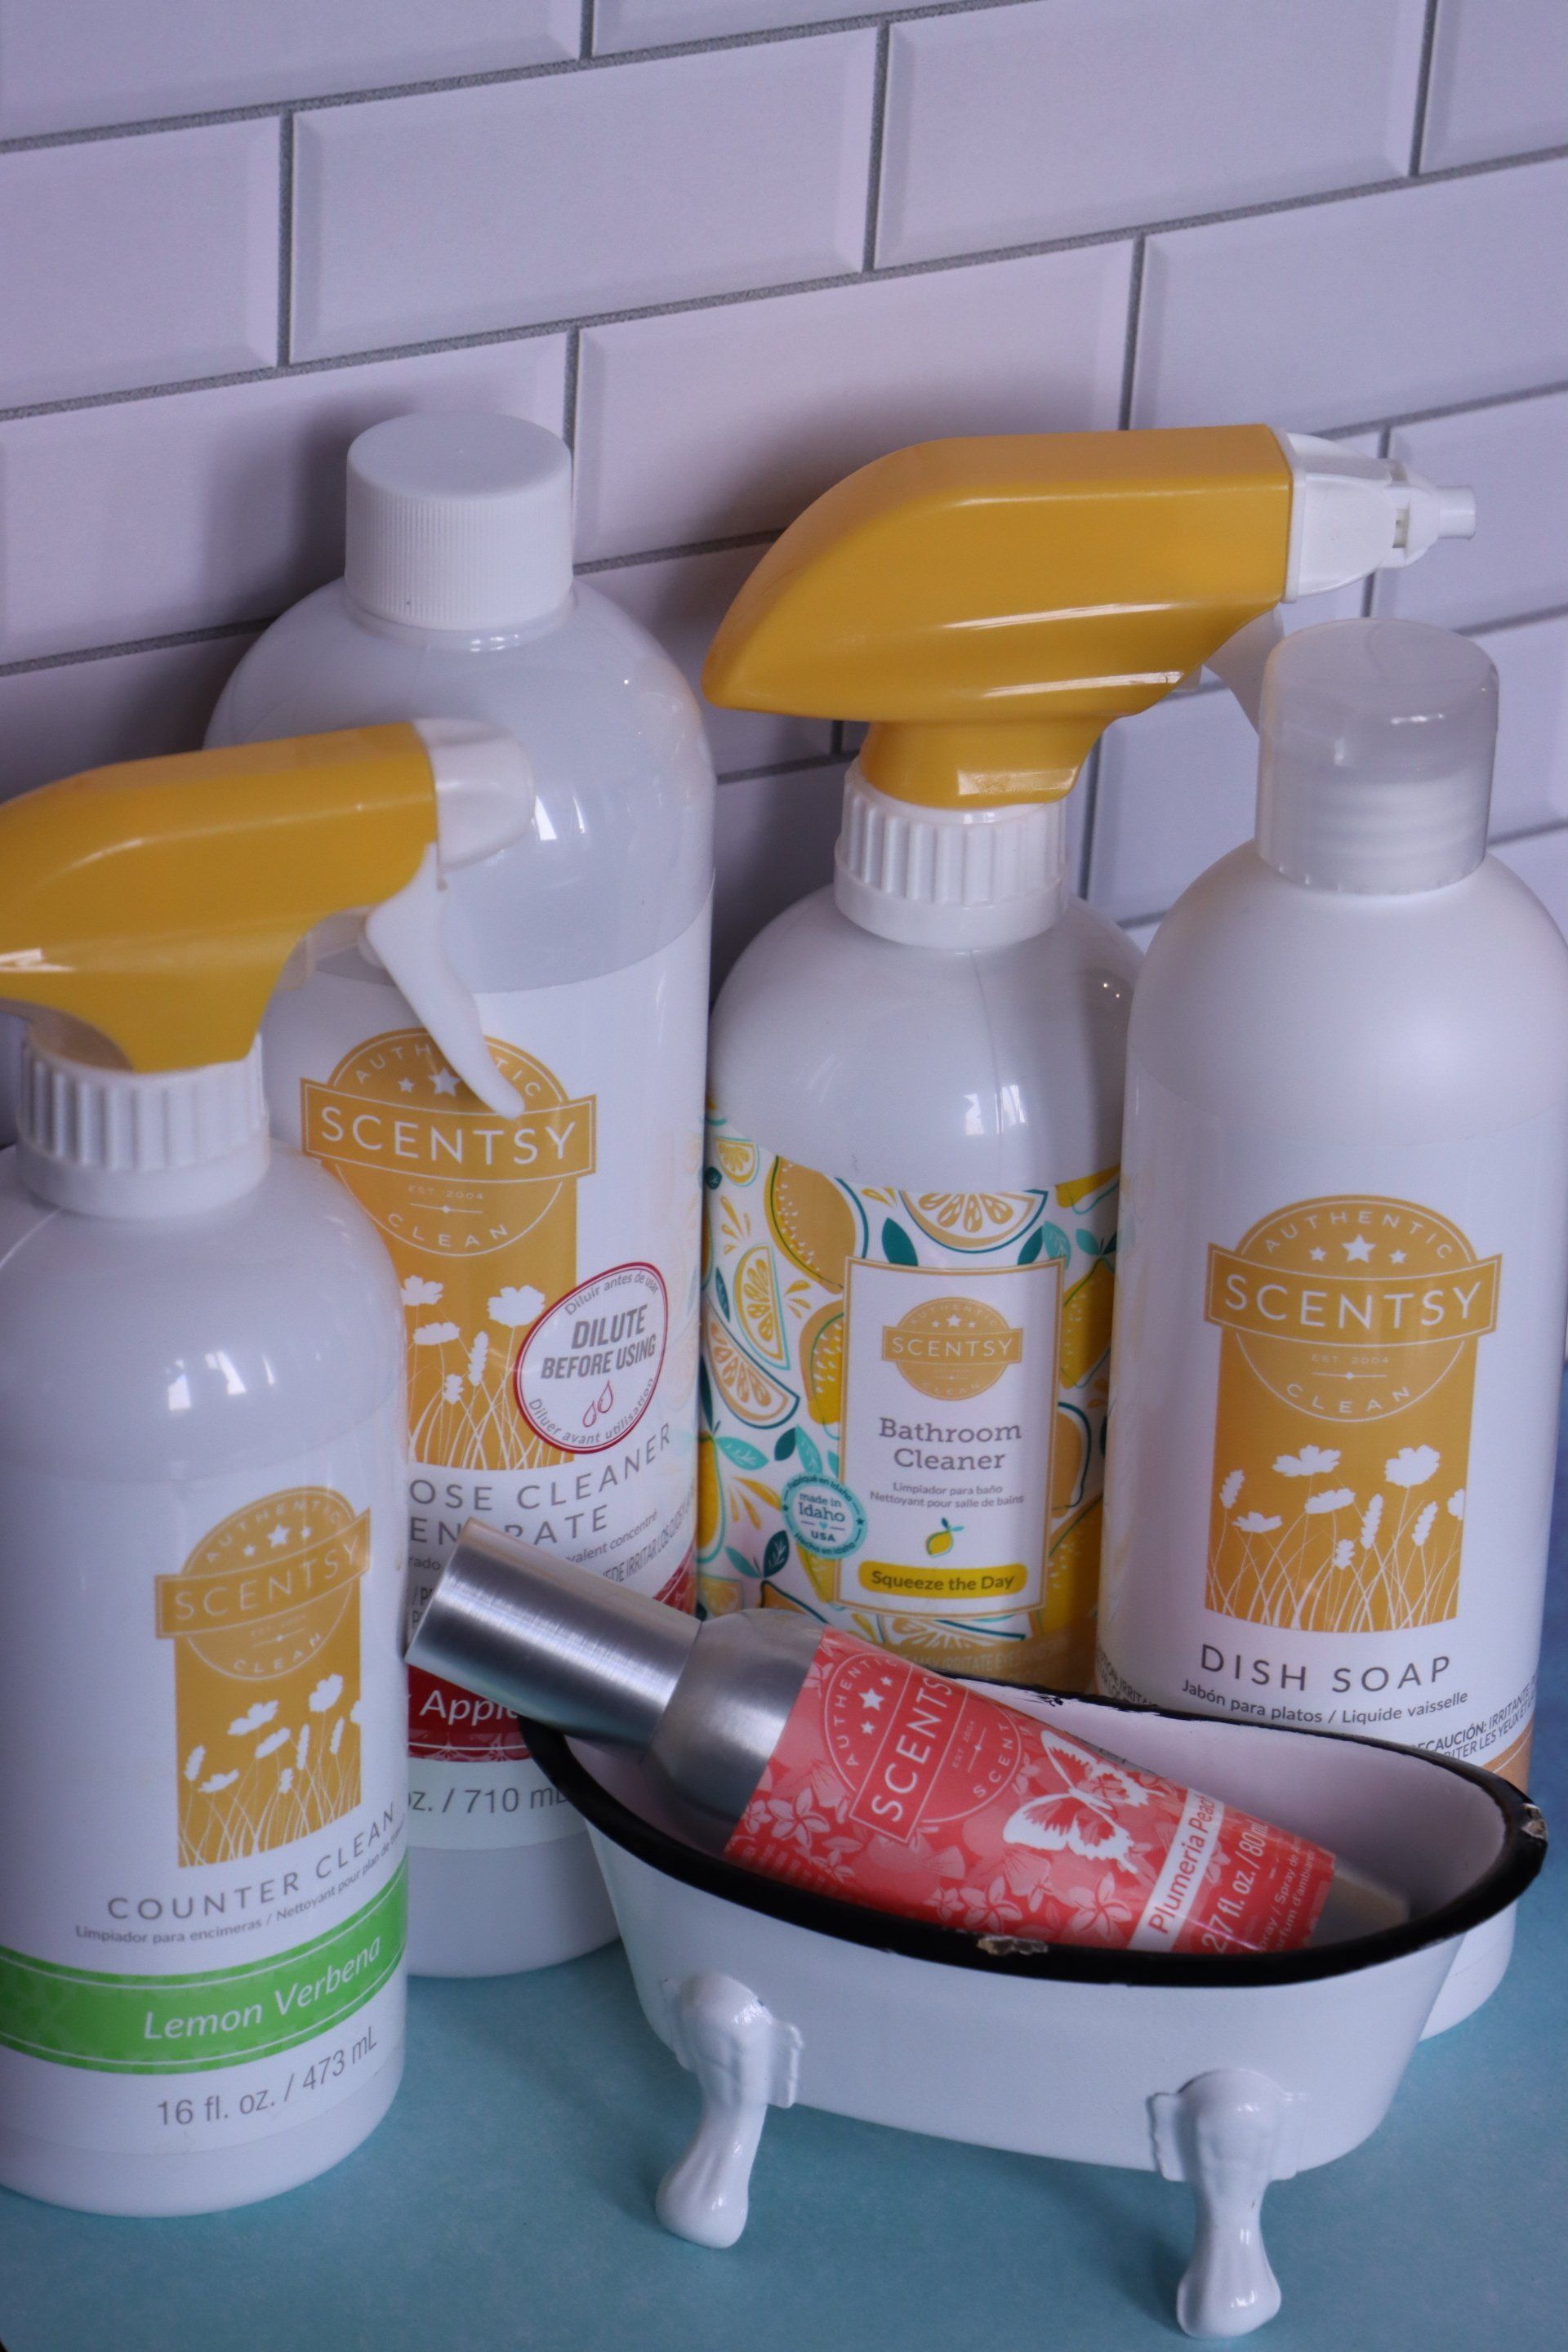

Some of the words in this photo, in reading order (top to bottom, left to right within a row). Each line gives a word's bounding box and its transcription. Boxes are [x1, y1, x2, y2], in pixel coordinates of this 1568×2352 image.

[356, 1044, 541, 1097] AUTHTIC
[321, 1106, 576, 1165] SCENTSY
[388, 1214, 508, 1247] CLEAN
[1266, 1210, 1452, 1258] AUTHENTIC
[564, 1285, 600, 1316] Diluir
[604, 1273, 632, 1291] antes
[634, 1271, 645, 1284] de
[1225, 1273, 1481, 1330] SCENTSY
[571, 1304, 648, 1349] DILUTE
[892, 1336, 1013, 1357] SCENTSY
[541, 1351, 613, 1379] BEFORE
[616, 1334, 657, 1370] USING
[1312, 1353, 1339, 1363] EST
[1352, 1356, 1389, 1365] 2004
[528, 1397, 562, 1435] Diluer
[562, 1432, 601, 1445] avant
[605, 1378, 654, 1440] utilisation
[1287, 1383, 1410, 1414] CLEAN
[879, 1417, 1022, 1443] Bathroom
[517, 1423, 670, 1509] CLEANER
[893, 1448, 1006, 1470] Cleaner
[798, 1501, 845, 1522] Idaho
[799, 1493, 828, 1506] made
[831, 1497, 842, 1508] in
[870, 1491, 924, 1508] Nettoyant
[927, 1499, 951, 1508] pour
[955, 1496, 978, 1508] salle
[981, 1494, 994, 1507] de
[996, 1494, 1025, 1507] bains
[893, 1482, 947, 1496] Limpiador
[950, 1486, 973, 1496] para
[976, 1483, 1003, 1494] baño
[207, 1500, 341, 1563] AUTHENTIC
[811, 1530, 836, 1543] USA
[174, 1535, 360, 1620] SCENTSY
[871, 1570, 944, 1591] Squeeze
[948, 1576, 976, 1591] the
[981, 1575, 1015, 1590] Day
[234, 1633, 321, 1673] CLEAN
[1200, 1643, 1306, 1691] DISH
[1332, 1655, 1450, 1693] SOAP
[834, 1659, 898, 1767] AUTHENTIC
[1182, 1679, 1225, 1706] Jabón
[1230, 1698, 1265, 1716] para
[1271, 1705, 1322, 1723] platos
[1327, 1709, 1337, 1724] /
[1342, 1707, 1402, 1725] Liquide
[1406, 1690, 1468, 1717] vaisselle
[871, 1677, 952, 1823] SCENTS
[1479, 1729, 1496, 1750] LES
[1498, 1713, 1520, 1737] YEUX
[952, 1748, 964, 1768] EST
[973, 1723, 1013, 1798] SCENT
[408, 1790, 432, 1811] z.
[442, 1788, 455, 1813] /
[465, 1788, 519, 1814] 710
[108, 1871, 299, 1920] COUNTER
[315, 1802, 394, 1878] CLEAN
[1238, 1832, 1266, 1857] 80
[75, 1924, 148, 1943] Limpiador
[153, 1931, 185, 1944] para
[189, 1918, 261, 1941] encimeras
[276, 1886, 335, 1921] Nettoyant
[338, 1869, 360, 1894] pour
[362, 1854, 380, 1877] plan
[1148, 1833, 1206, 1935] Plumeria
[1232, 1870, 1257, 1895] oz.
[1274, 1868, 1296, 1905] Spray
[1217, 1897, 1245, 1918] fl.
[144, 2003, 263, 2039] Lemon
[274, 1936, 381, 2016] Verbena
[158, 2098, 194, 2126] 16
[204, 2095, 229, 2121] fl.
[239, 2089, 275, 2114] oz.
[283, 2073, 295, 2102] /
[302, 2049, 345, 2090] 473
[351, 2025, 377, 2065] mL
